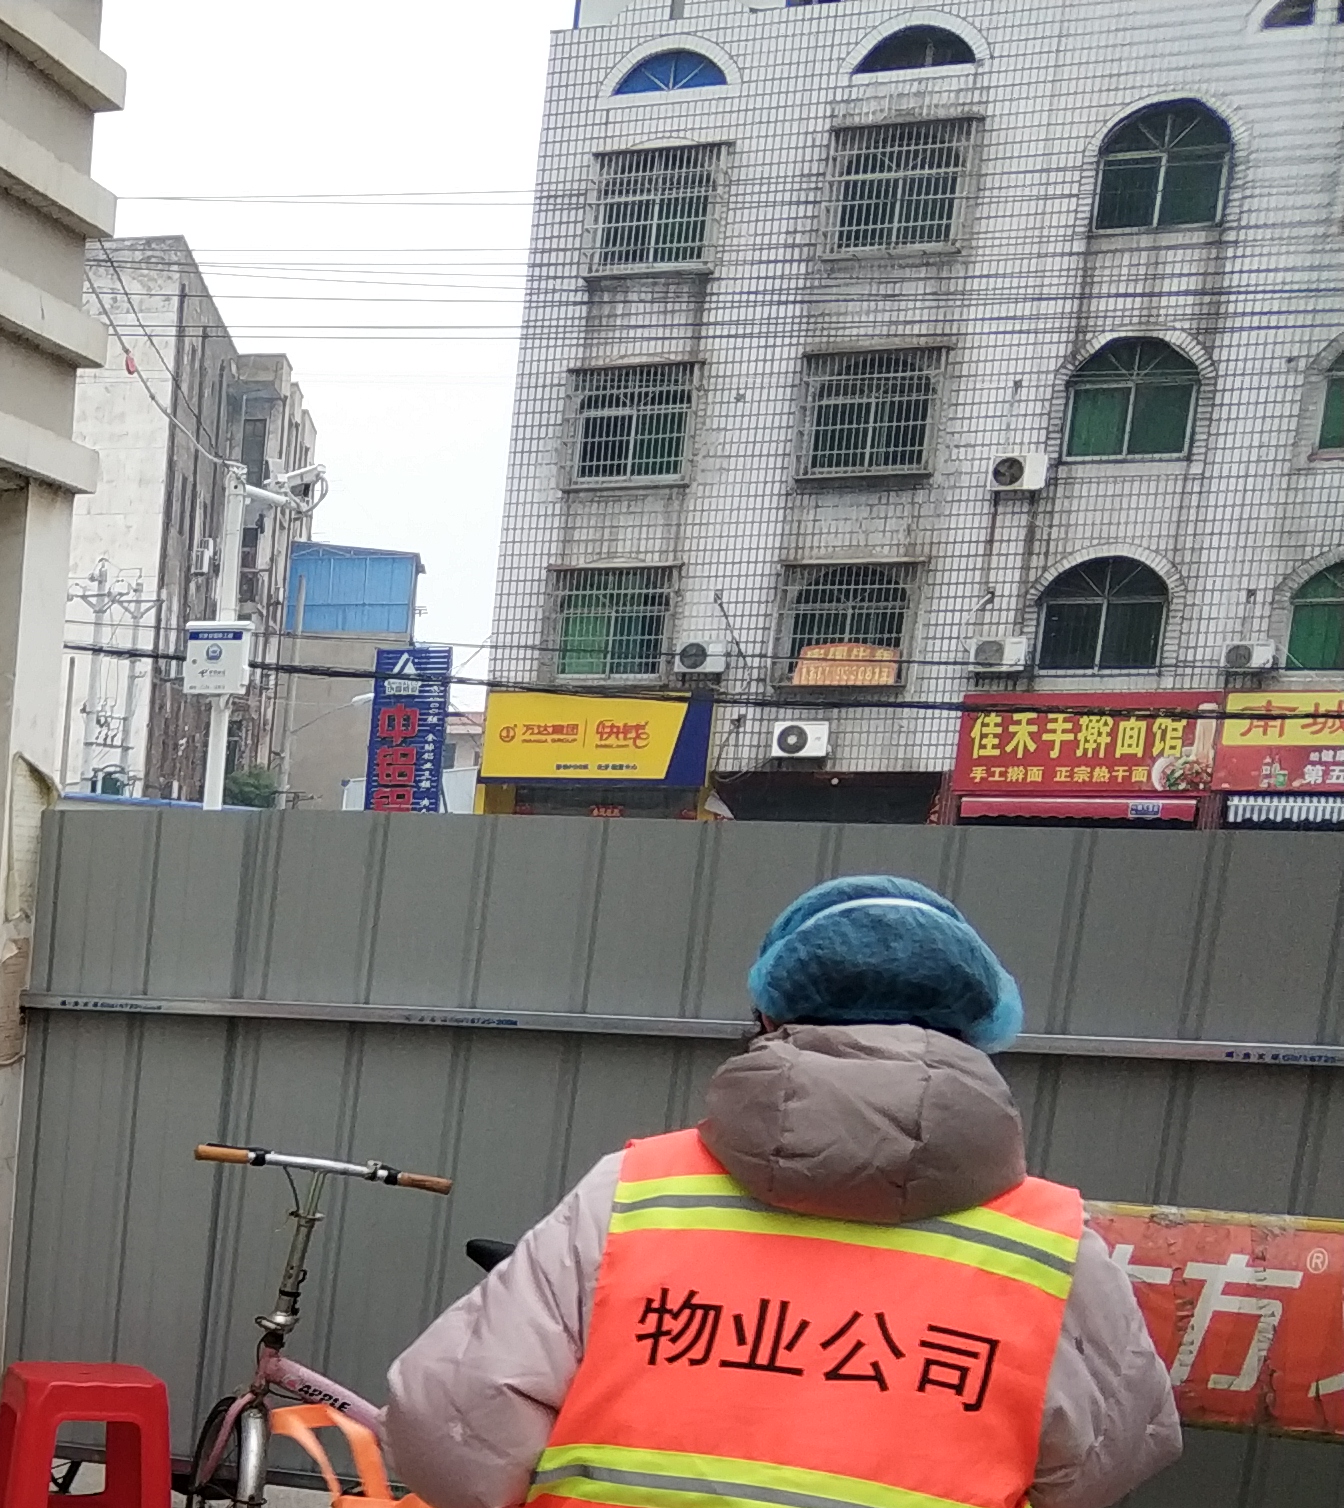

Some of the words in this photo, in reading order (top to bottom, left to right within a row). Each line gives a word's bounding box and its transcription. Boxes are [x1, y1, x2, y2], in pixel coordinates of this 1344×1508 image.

[1054, 766, 1149, 783] 正宗热干面
[634, 1287, 1001, 1412] 物业公司
